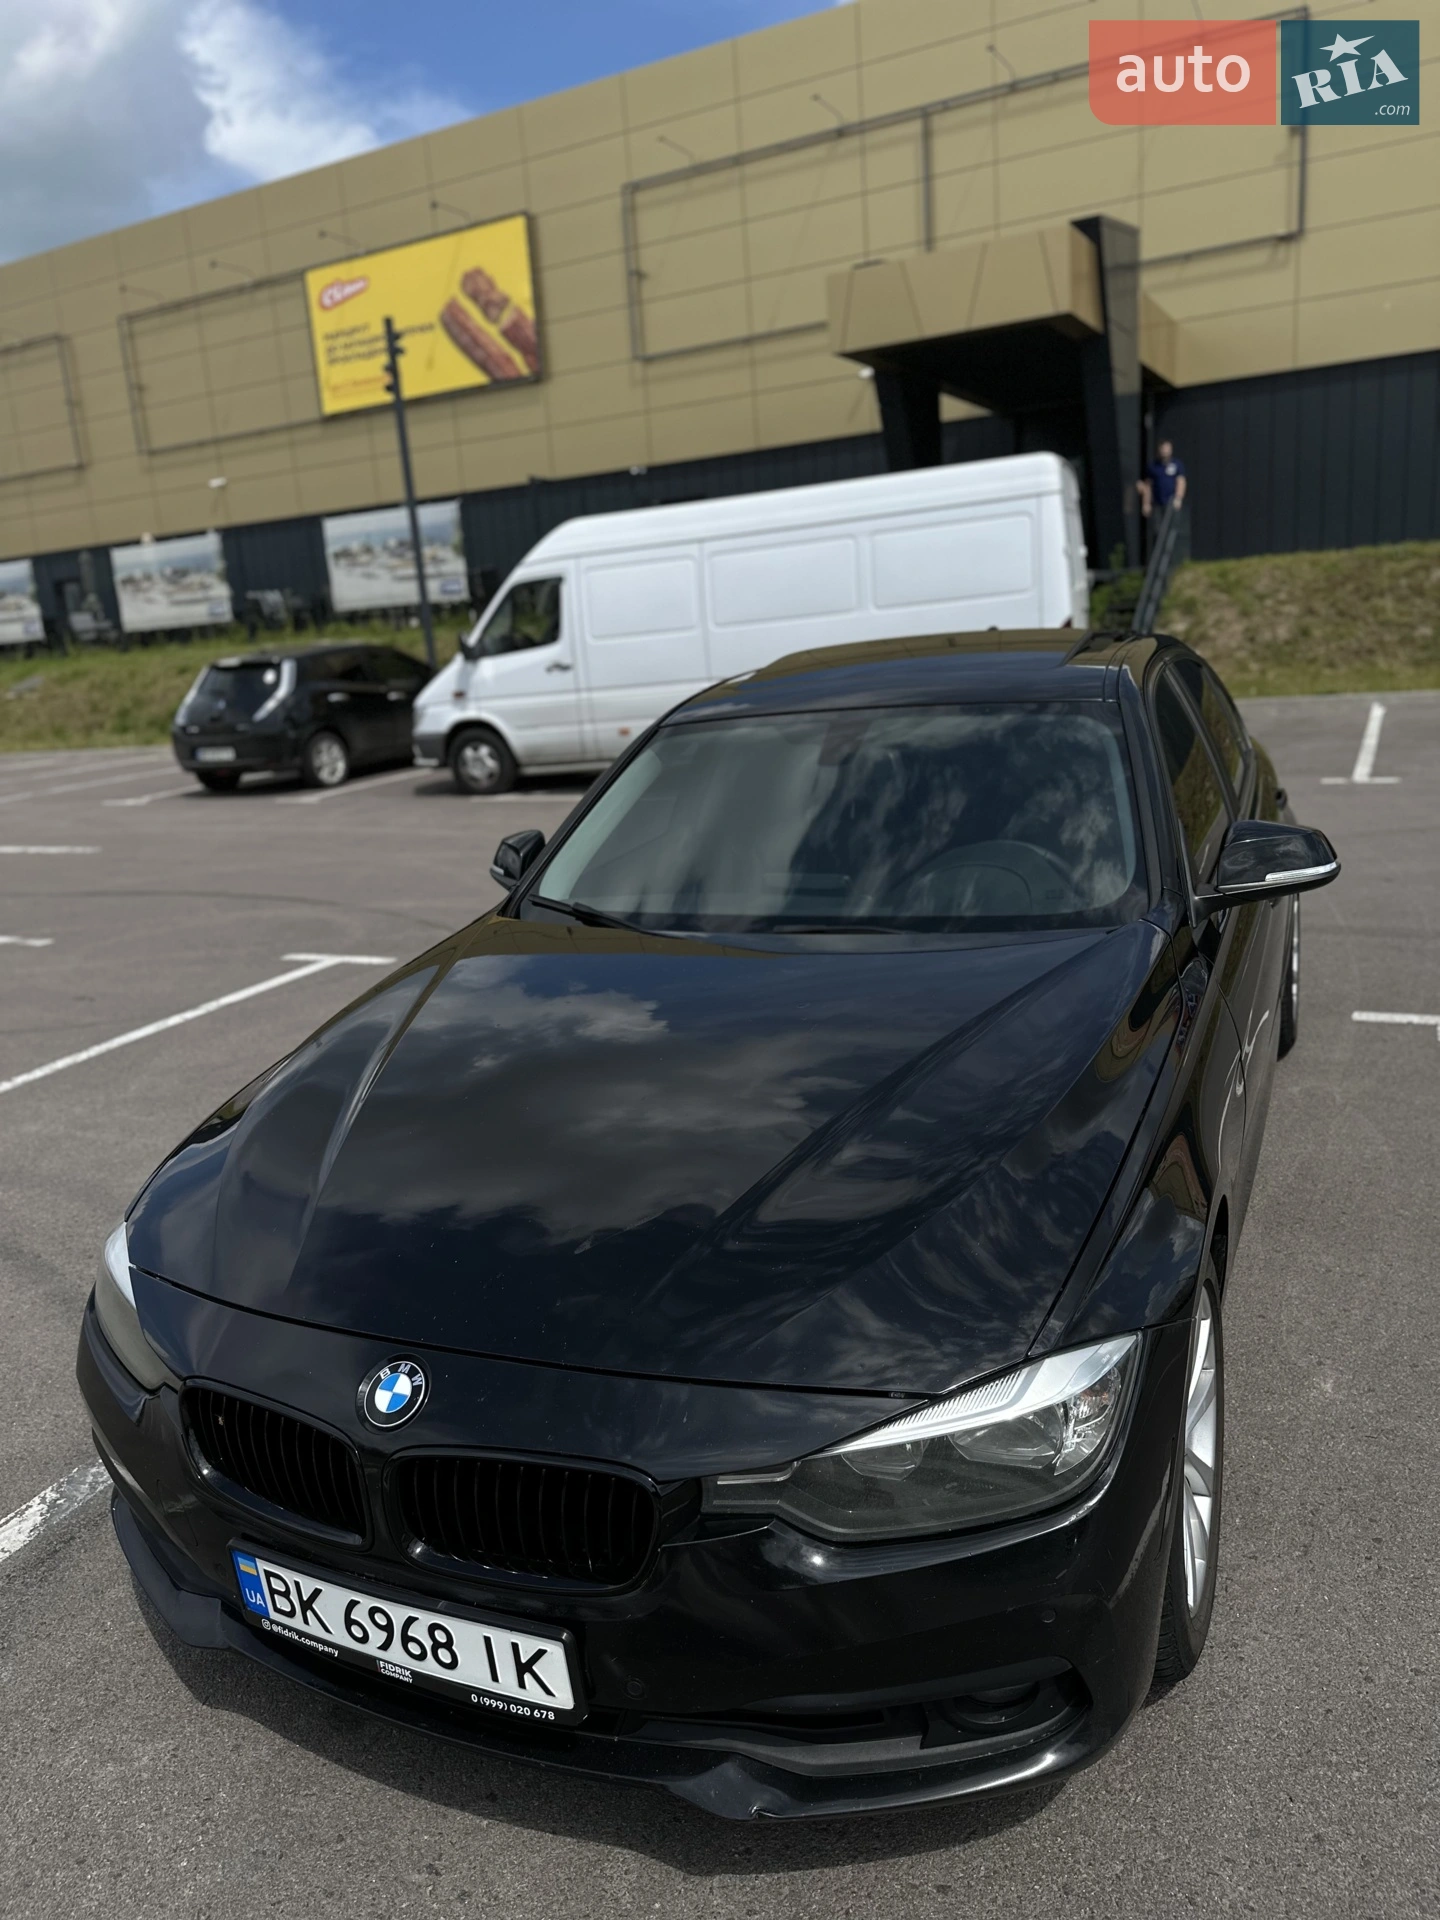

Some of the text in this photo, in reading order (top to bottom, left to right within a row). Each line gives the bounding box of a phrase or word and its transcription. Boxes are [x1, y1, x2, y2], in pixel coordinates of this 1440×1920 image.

[379, 1362, 424, 1387] BMW
[245, 1588, 265, 1608] UA
[263, 1568, 557, 1699] BK 6968 IK
[271, 1623, 339, 1657] @fidrik.company
[380, 1660, 412, 1678] FIDRIK
[380, 1668, 413, 1684] COMPANY
[471, 1693, 555, 1720] 0 (999) 020 678
